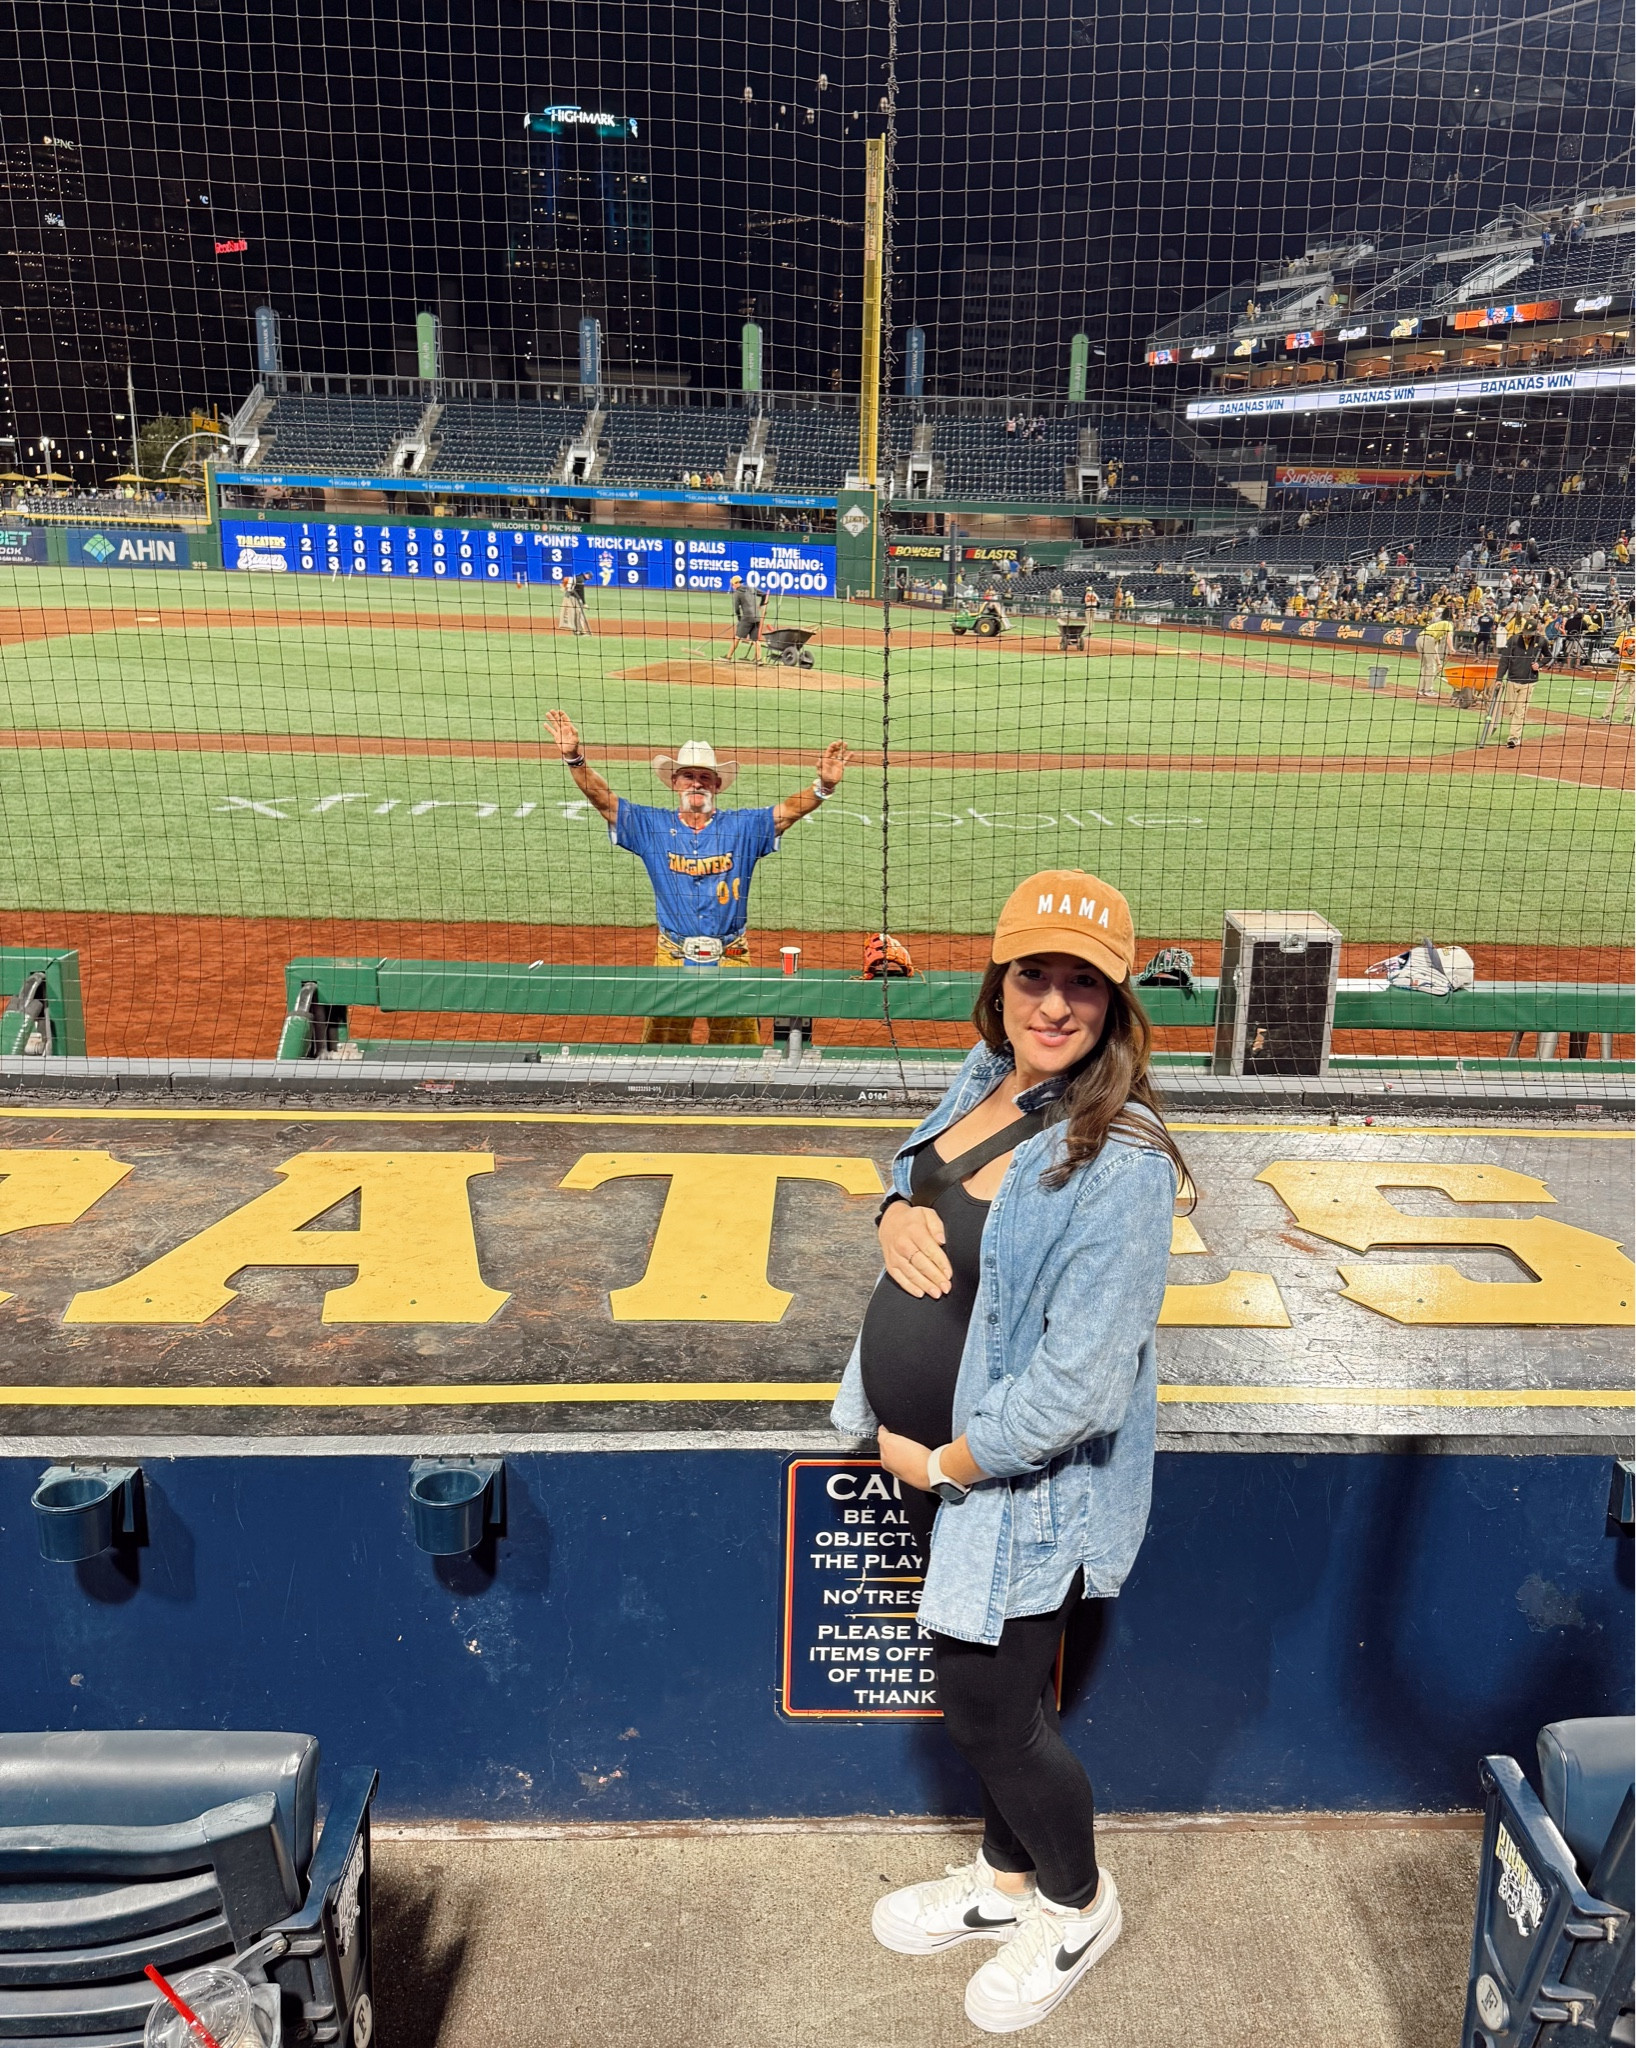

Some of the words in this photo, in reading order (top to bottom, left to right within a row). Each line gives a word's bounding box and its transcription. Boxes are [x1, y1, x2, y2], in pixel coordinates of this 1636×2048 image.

[551, 108, 616, 127] HIGHMARK
[54, 137, 75, 151] PNC
[1480, 376, 1545, 393] BANANAS
[1547, 373, 1574, 388] WIN
[1338, 390, 1391, 405] BANANAS
[1393, 386, 1415, 400] WIN
[1218, 400, 1264, 414] BANANAS
[1266, 398, 1285, 411] WIN
[1282, 468, 1334, 485] Surfside
[492, 521, 529, 531] WELCOME
[530, 523, 540, 531] TO
[549, 524, 564, 532] PNC
[565, 525, 582, 533] PARK
[301, 524, 309, 536] 1
[327, 524, 337, 537] 2
[354, 525, 363, 538] 3
[381, 526, 390, 539] 4
[408, 528, 416, 540] 5
[434, 529, 443, 541] 6
[461, 530, 470, 542] 7
[487, 531, 497, 543] 8
[514, 532, 524, 545] 9
[534, 534, 579, 548] POINTS
[586, 537, 622, 550] TRICK
[624, 538, 663, 551] PLAYS
[118, 538, 176, 562] AHN
[301, 538, 311, 552] 2
[327, 539, 338, 553] 2
[354, 540, 364, 554] 0
[380, 541, 392, 554] 5
[407, 542, 418, 556] 0
[433, 543, 445, 557] 0
[460, 544, 472, 558] 0
[487, 545, 498, 559] 0
[551, 549, 562, 563] 3
[627, 552, 639, 566] 9
[674, 541, 685, 555] 0
[689, 542, 726, 555] BALLS
[771, 547, 800, 559] TIME
[895, 545, 943, 559] BOWSER
[973, 548, 1017, 562] BLASTS
[301, 555, 313, 569] 0
[328, 556, 339, 571] 3
[354, 557, 366, 571] 0
[381, 558, 393, 572] 2
[408, 559, 419, 573] 2
[434, 561, 446, 574] 0
[461, 562, 472, 576] 0
[488, 563, 499, 577] 0
[551, 566, 563, 580] 8
[627, 569, 639, 583] 9
[675, 557, 685, 571] 0
[689, 558, 739, 572] STRIKES
[750, 557, 824, 571] REMAINING:
[675, 574, 685, 587] 0
[689, 575, 722, 588] OUTS
[746, 570, 828, 591] 0:00:00
[1037, 893, 1109, 929] MAMA
[844, 1509, 876, 1525] BE
[810, 1554, 858, 1569] THE
[823, 1590, 858, 1605] NO
[817, 1625, 911, 1640] PLEASE
[809, 1646, 880, 1662] ITEMS
[885, 1647, 934, 1661] OFF
[828, 1668, 862, 1683] OF
[865, 1668, 913, 1683] THE
[919, 1668, 938, 1683] D
[854, 1689, 937, 1704] THANK
